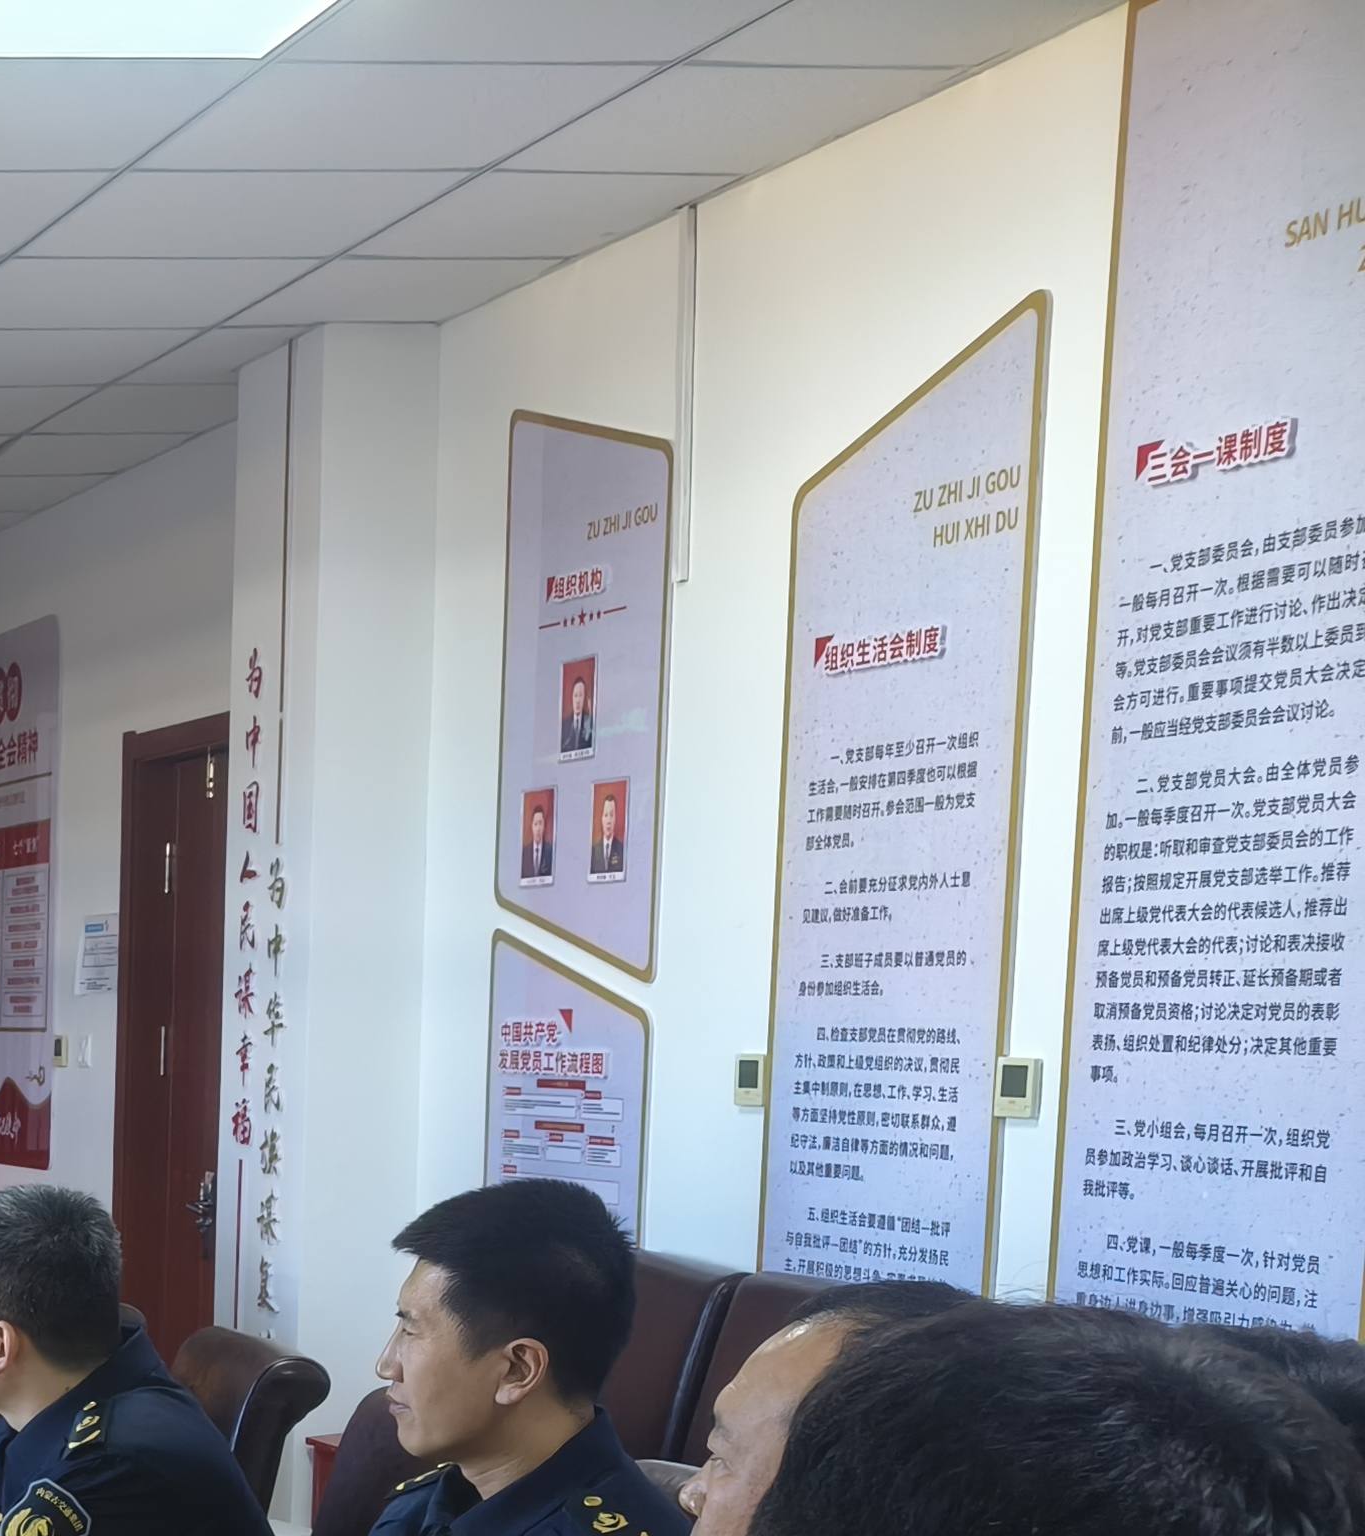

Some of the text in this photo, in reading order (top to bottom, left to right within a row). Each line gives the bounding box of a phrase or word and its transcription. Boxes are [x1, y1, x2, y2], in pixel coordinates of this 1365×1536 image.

[1285, 208, 1330, 248] SAN
[1147, 420, 1288, 483] 三会一课制度
[913, 465, 1021, 513] ZU ZHI JI GOU
[587, 503, 658, 540] ZU ZHI JI GOU
[934, 507, 1019, 548] HUI XHI DU
[554, 567, 602, 599] 组织机构
[1119, 552, 1365, 613] 一般每月召开一次。根据需要可以随时
[824, 626, 940, 671] 组织生活会制度
[232, 647, 263, 1148] 为中国人民谋幸福
[501, 1021, 558, 1044] 中国共产党
[499, 1049, 604, 1075] 发展党员工作流程图
[1091, 1065, 1118, 1083] 事项。
[1083, 1180, 1134, 1200] 我批评等。
